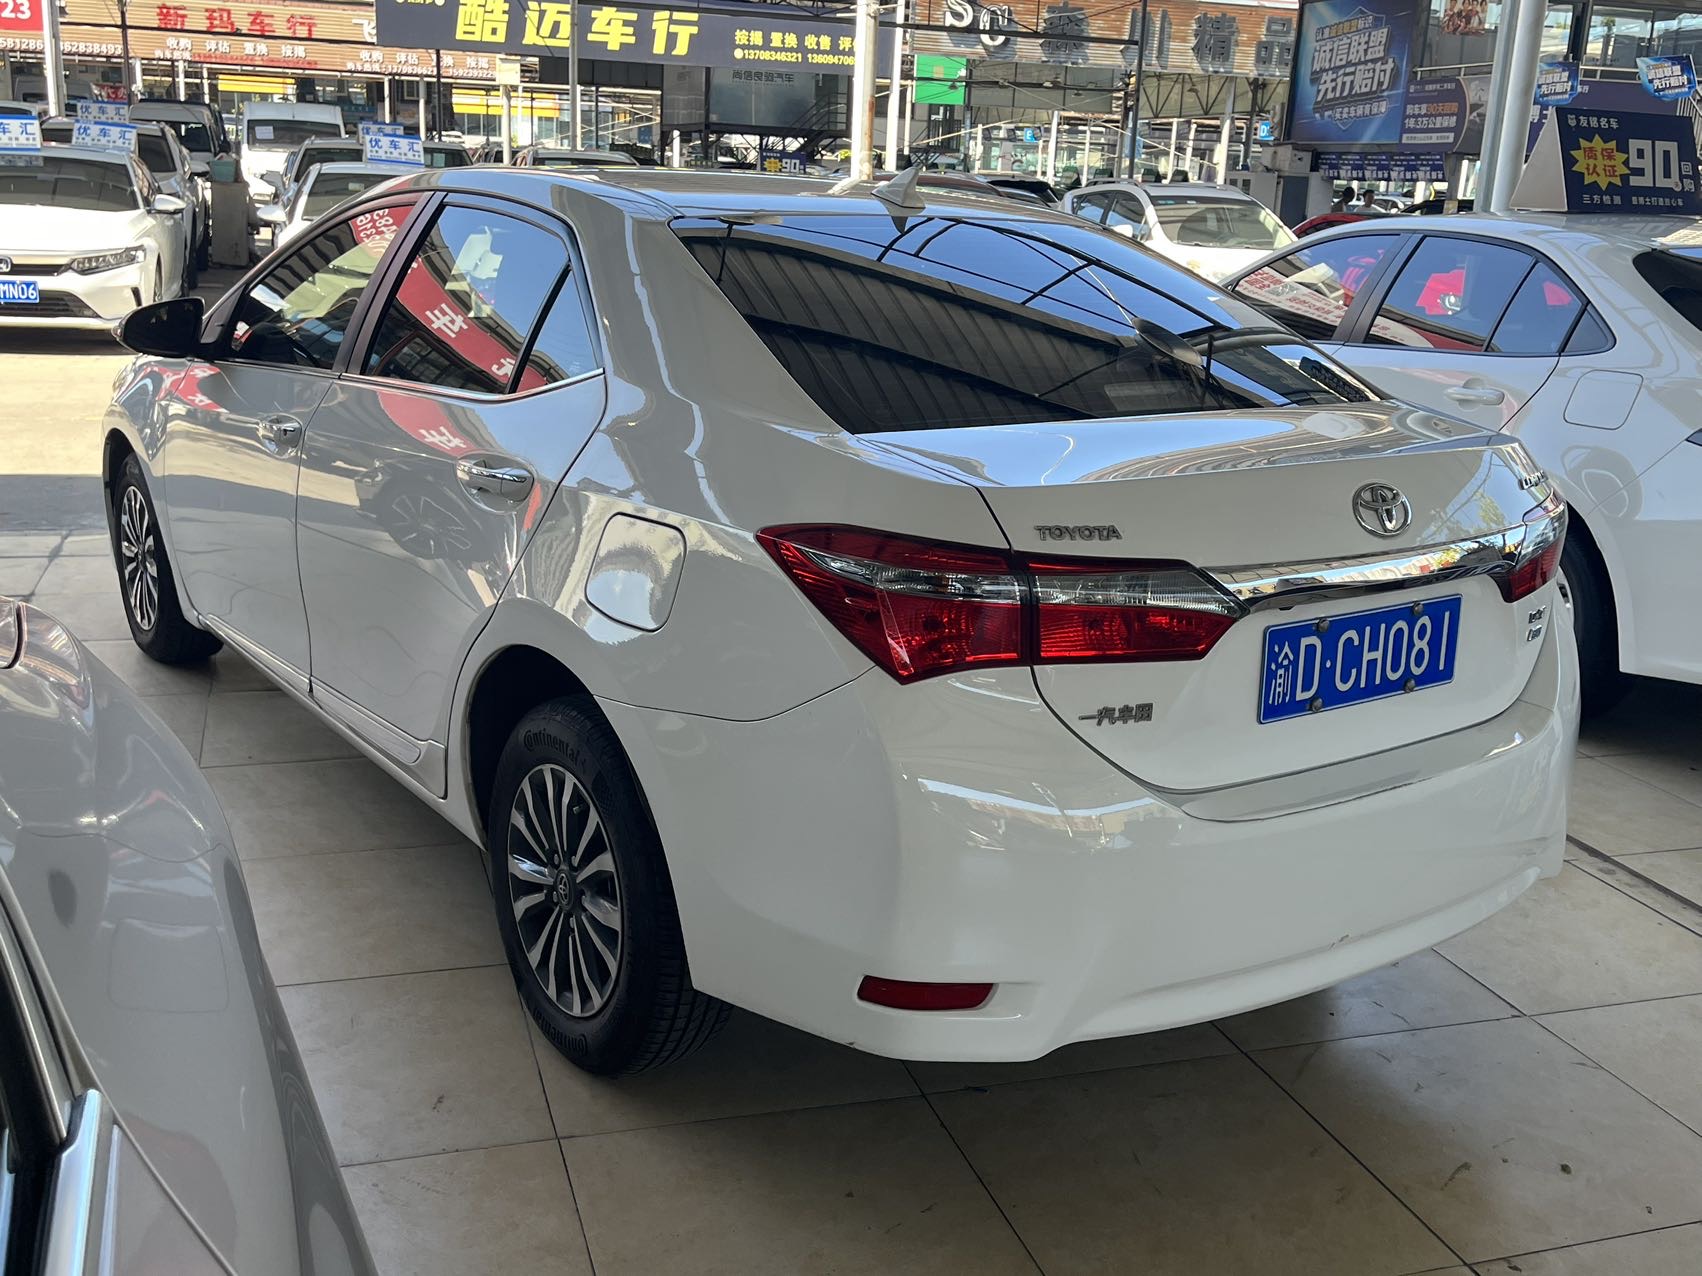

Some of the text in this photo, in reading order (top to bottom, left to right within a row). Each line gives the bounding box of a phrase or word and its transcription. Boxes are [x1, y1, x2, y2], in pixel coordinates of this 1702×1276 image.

[156, 4, 318, 38] 新玛车行
[455, 0, 699, 56] 酷迈车行
[166, 37, 306, 58] 收购 评估 置换 按揭
[735, 29, 763, 46] 按揭
[770, 32, 798, 48] 置换
[360, 50, 384, 62] 收购
[396, 52, 419, 65] 评估
[1312, 28, 1388, 72] 诚信联盟
[1316, 58, 1394, 101] 先行赔付
[80, 103, 126, 117] 优车汇
[76, 125, 133, 140] 优车汇
[369, 136, 421, 153] 优车汇
[1583, 147, 1617, 161] 质保
[1585, 163, 1618, 178] 认证
[1628, 138, 1679, 188] 90
[1034, 525, 1123, 541] TOYOTA
[523, 728, 580, 767] Continental
